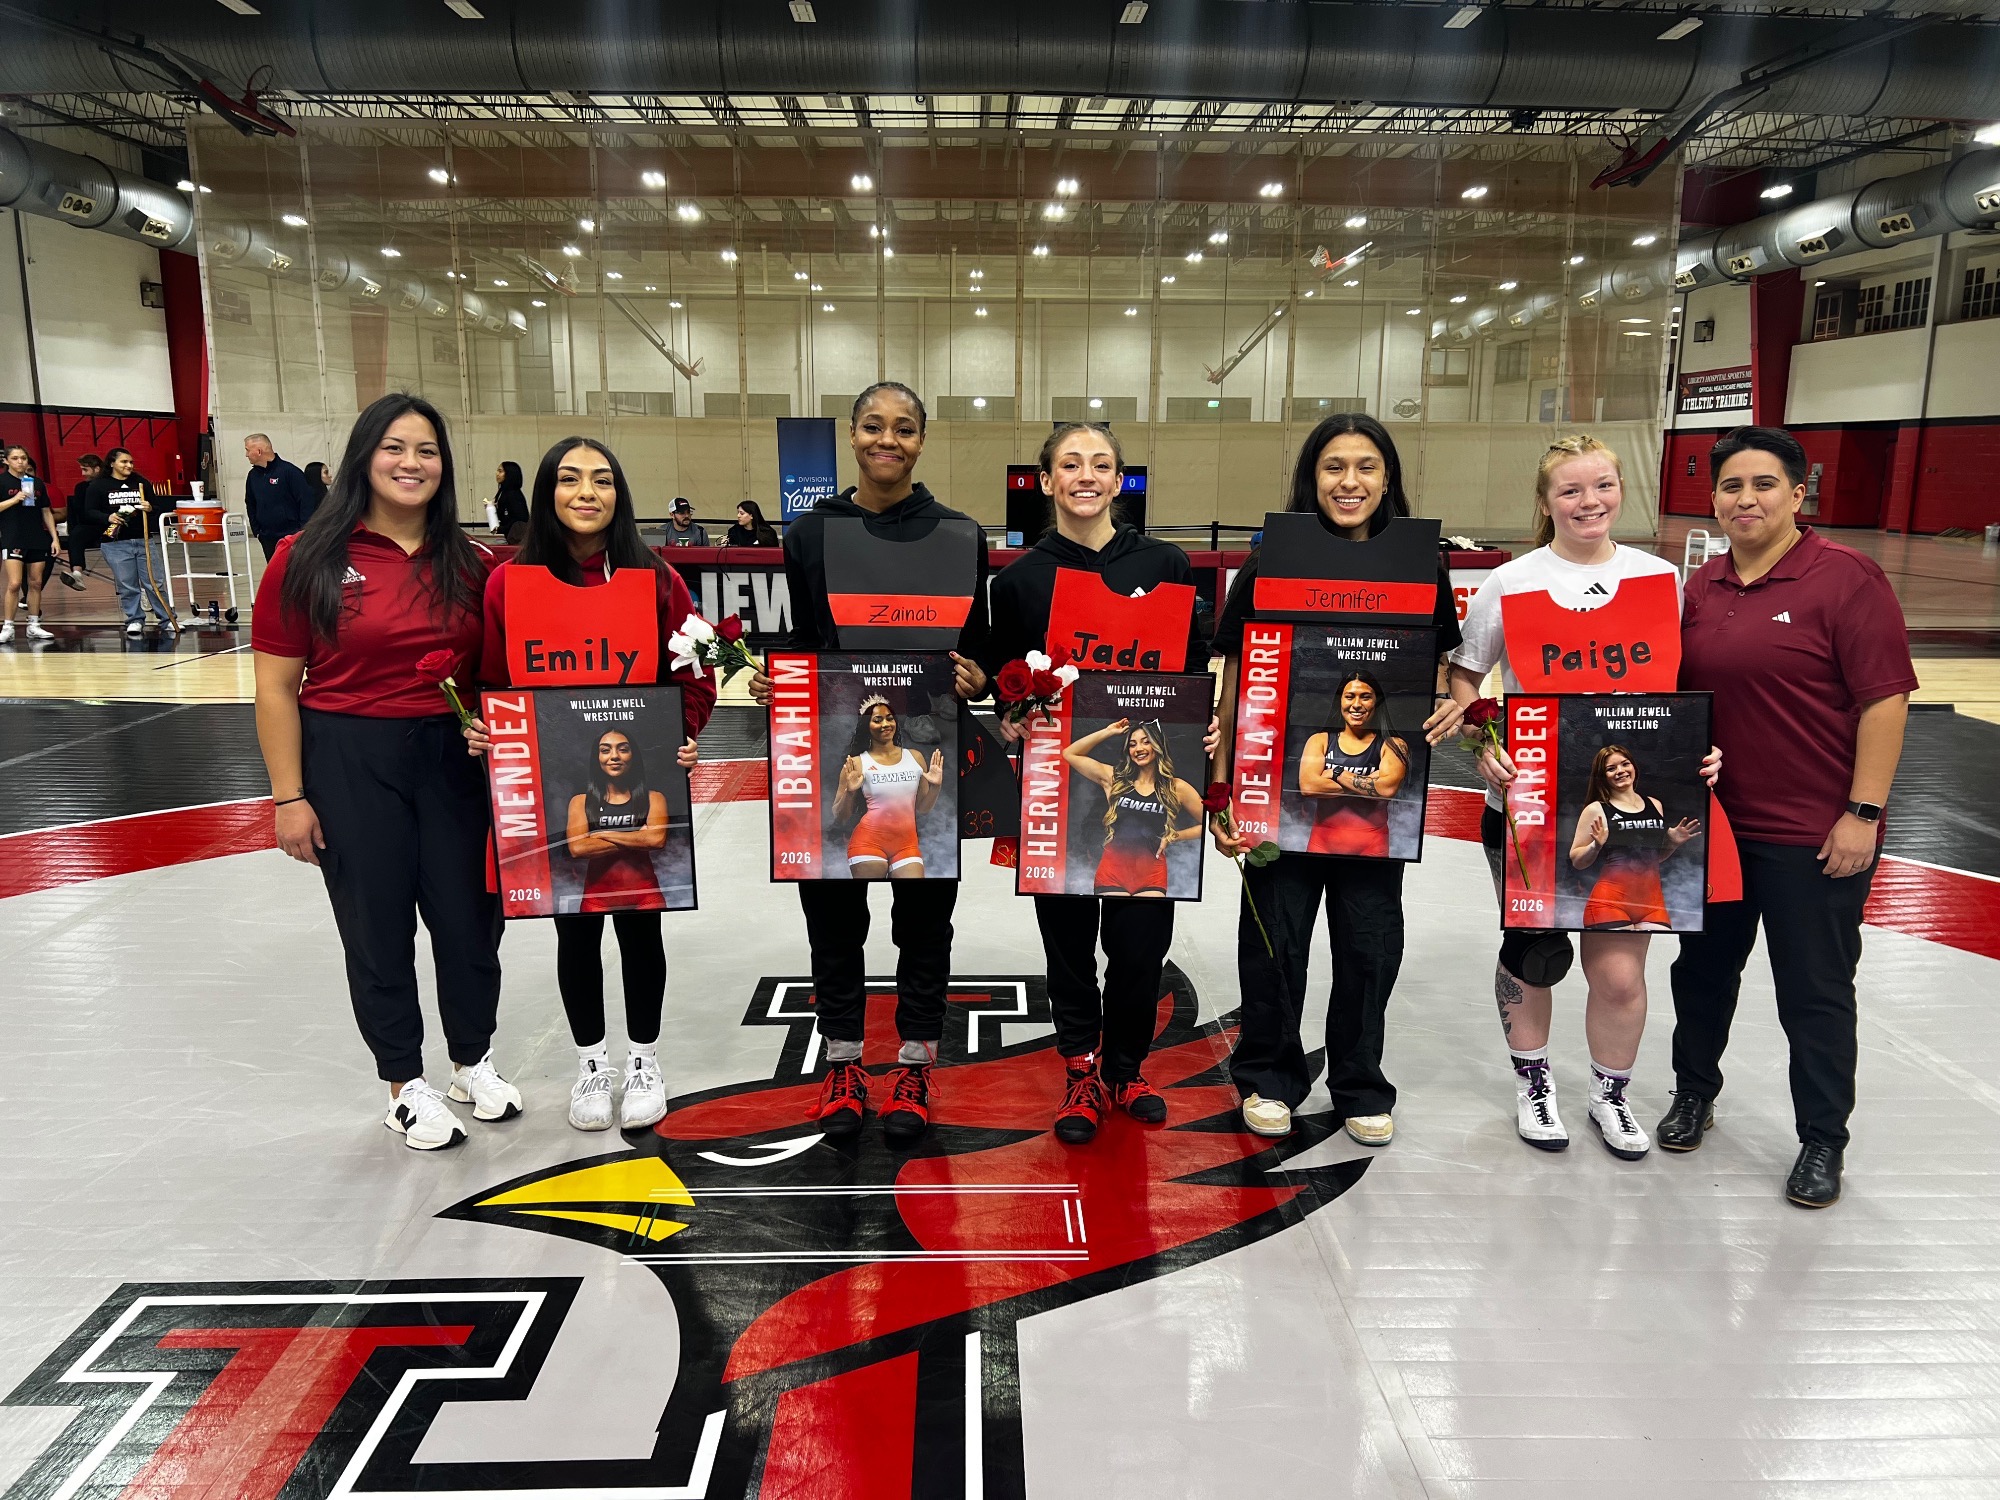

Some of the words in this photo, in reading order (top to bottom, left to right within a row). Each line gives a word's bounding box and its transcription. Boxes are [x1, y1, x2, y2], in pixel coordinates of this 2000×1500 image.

[1705, 374, 1728, 383] HOSPITAL
[1728, 371, 1745, 380] SPORTS
[1699, 385, 1713, 393] OFFICIAL
[1714, 383, 1736, 392] HEALTHCARE
[1682, 396, 1714, 411] ATHLETIC
[1716, 392, 1748, 409] TRAINING
[1017, 477, 1025, 487] 0
[1129, 478, 1136, 488] 0
[108, 491, 141, 499] CARDINA
[826, 485, 835, 493] IT
[108, 497, 142, 505] WRESTLIN
[1305, 587, 1389, 611] Jennifer
[867, 604, 938, 624] Zainab
[1326, 636, 1364, 648] WILLIAM
[1366, 638, 1400, 650] JEWELL
[1071, 631, 1162, 671] Jada
[1337, 650, 1387, 662] WRESTLING
[524, 637, 639, 685] Emily
[1541, 640, 1652, 680] Paige
[851, 664, 889, 674] WILLIAM
[891, 664, 924, 674] JEWELL
[1245, 630, 1281, 718] TORRE
[863, 676, 912, 687] WRESTLING
[1106, 685, 1143, 695] WILLIAM
[1144, 686, 1177, 696] JEWELL
[570, 699, 609, 710] WILLIAM
[611, 698, 646, 709] JEWELL
[1117, 697, 1165, 708] WRESTLING
[583, 711, 635, 722] WRESTLING
[1595, 707, 1634, 717] WILLIAM
[1636, 706, 1672, 717] JEWELL
[1607, 719, 1659, 730] WRESTLING
[773, 658, 813, 810] IBRAHIM
[1242, 729, 1274, 762] LA
[487, 696, 538, 838] MENDEZ
[1515, 705, 1547, 826] BARBER
[871, 771, 918, 785] JEWELL
[1026, 700, 1063, 857] HERNAND
[1239, 772, 1271, 805] DE
[1238, 820, 1268, 834] 2026
[1617, 819, 1665, 831] JEWELL
[781, 851, 811, 864] 2026
[1025, 866, 1055, 879] 2026
[509, 888, 541, 902] 2026
[1511, 899, 1544, 912] 2026
